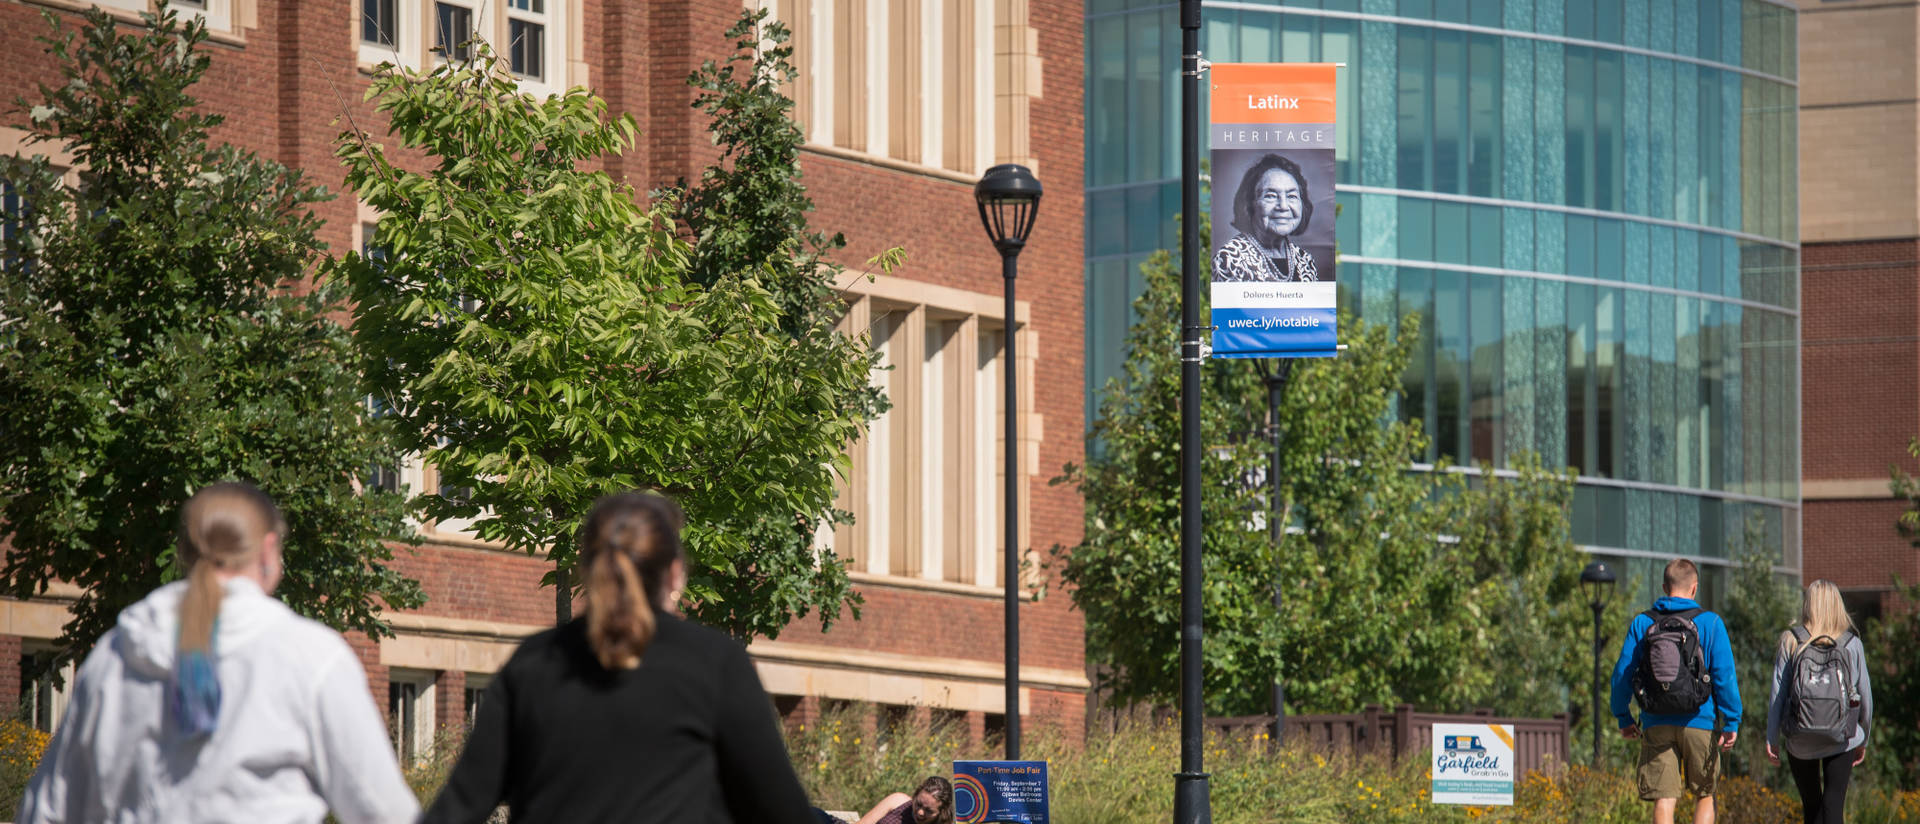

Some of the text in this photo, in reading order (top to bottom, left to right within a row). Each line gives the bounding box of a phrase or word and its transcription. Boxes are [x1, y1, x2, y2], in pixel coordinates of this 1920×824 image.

[1248, 94, 1299, 109] Latinx
[1224, 130, 1323, 142] HERITAGE
[1243, 290, 1304, 299] Dolores Huerta
[1228, 315, 1320, 330] uwec.ly/notable
[977, 766, 1041, 774] Part-Time Job Fair
[1437, 755, 1499, 774] Garfield
